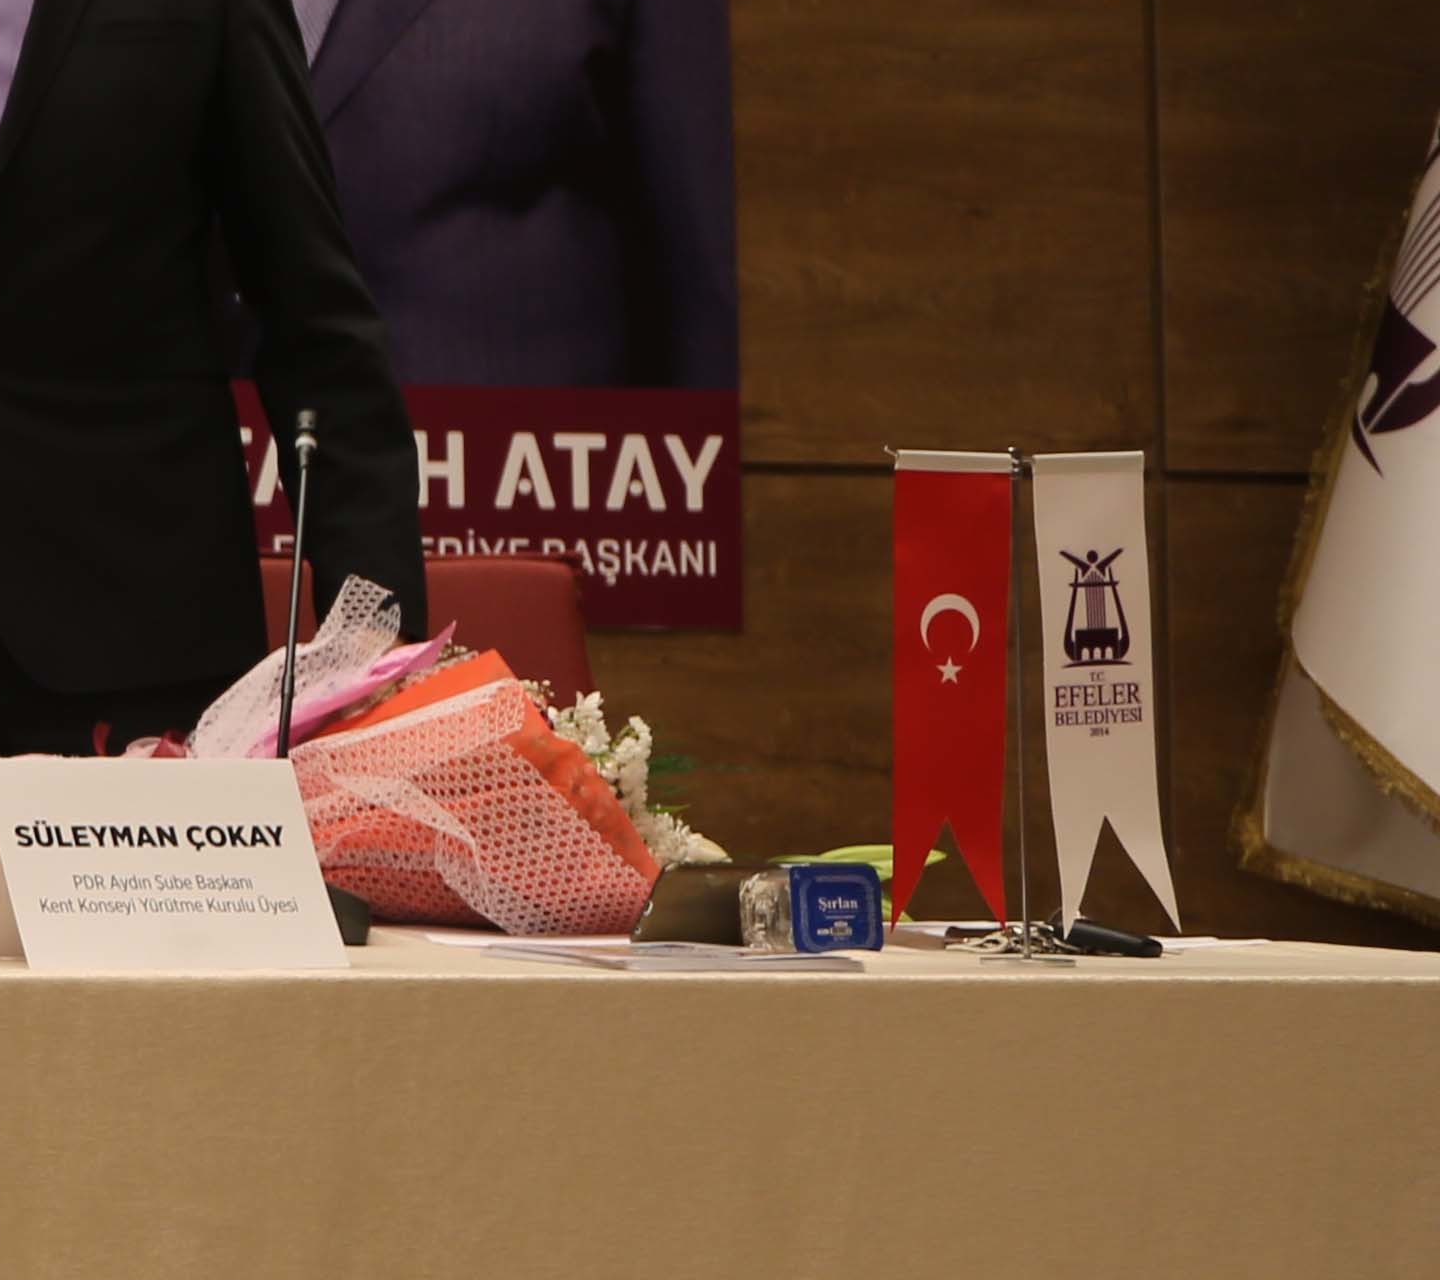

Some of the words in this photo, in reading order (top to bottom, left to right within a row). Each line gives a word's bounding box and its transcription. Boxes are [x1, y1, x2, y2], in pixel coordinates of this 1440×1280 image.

[494, 431, 724, 513] ATAY
[1054, 682, 1143, 709] EFELER
[1055, 705, 1144, 728] BELEDİYESİ
[14, 820, 180, 848] SÜLEYMAN
[185, 824, 284, 852] ÇOKAY
[72, 873, 106, 890] PDR
[110, 873, 153, 893] Aydın
[194, 873, 255, 893] Başkanı
[39, 897, 75, 914] Kent
[77, 897, 137, 916] Konseyi
[139, 897, 205, 915] Yürütme
[205, 897, 257, 914] Kurulu
[257, 893, 300, 916] Üyesi
